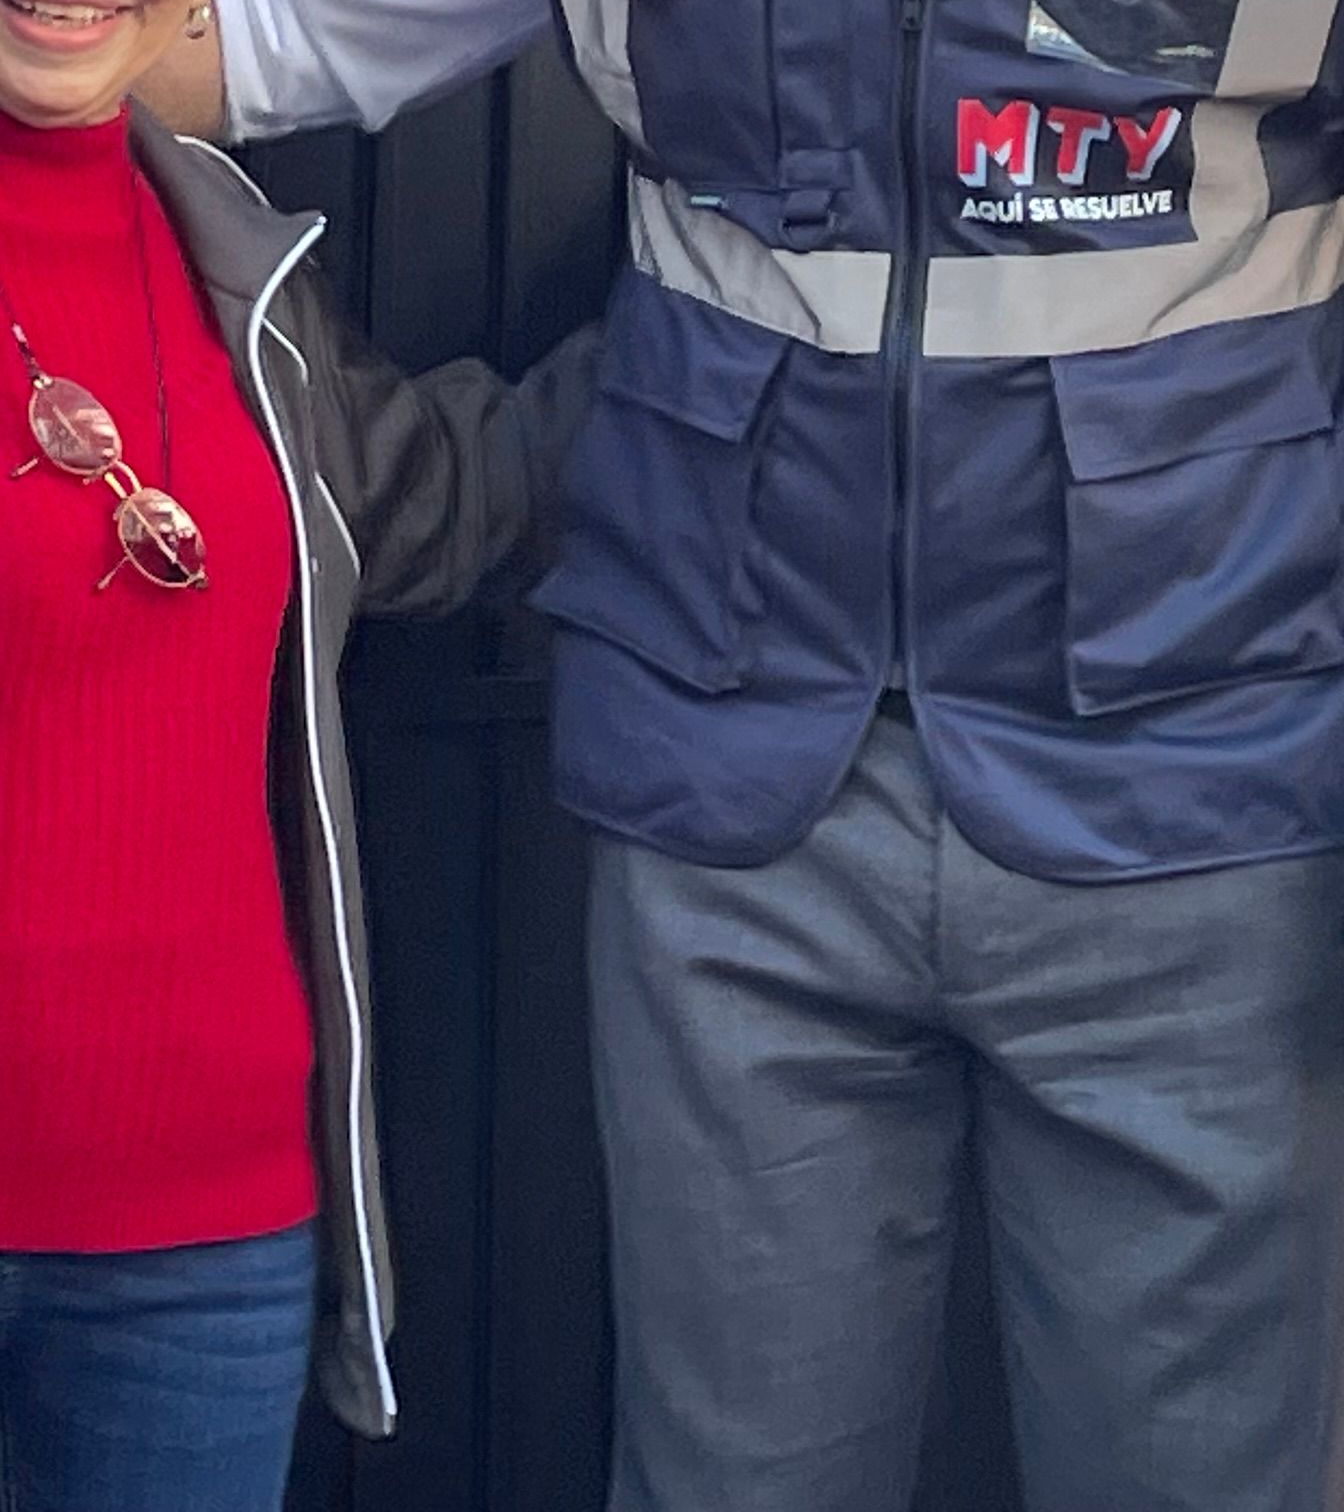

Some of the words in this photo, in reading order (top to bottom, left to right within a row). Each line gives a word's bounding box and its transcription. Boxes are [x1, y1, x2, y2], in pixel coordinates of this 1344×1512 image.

[958, 98, 1182, 187] MTY
[1029, 197, 1059, 222] SE
[1059, 190, 1173, 220] RESUELVE
